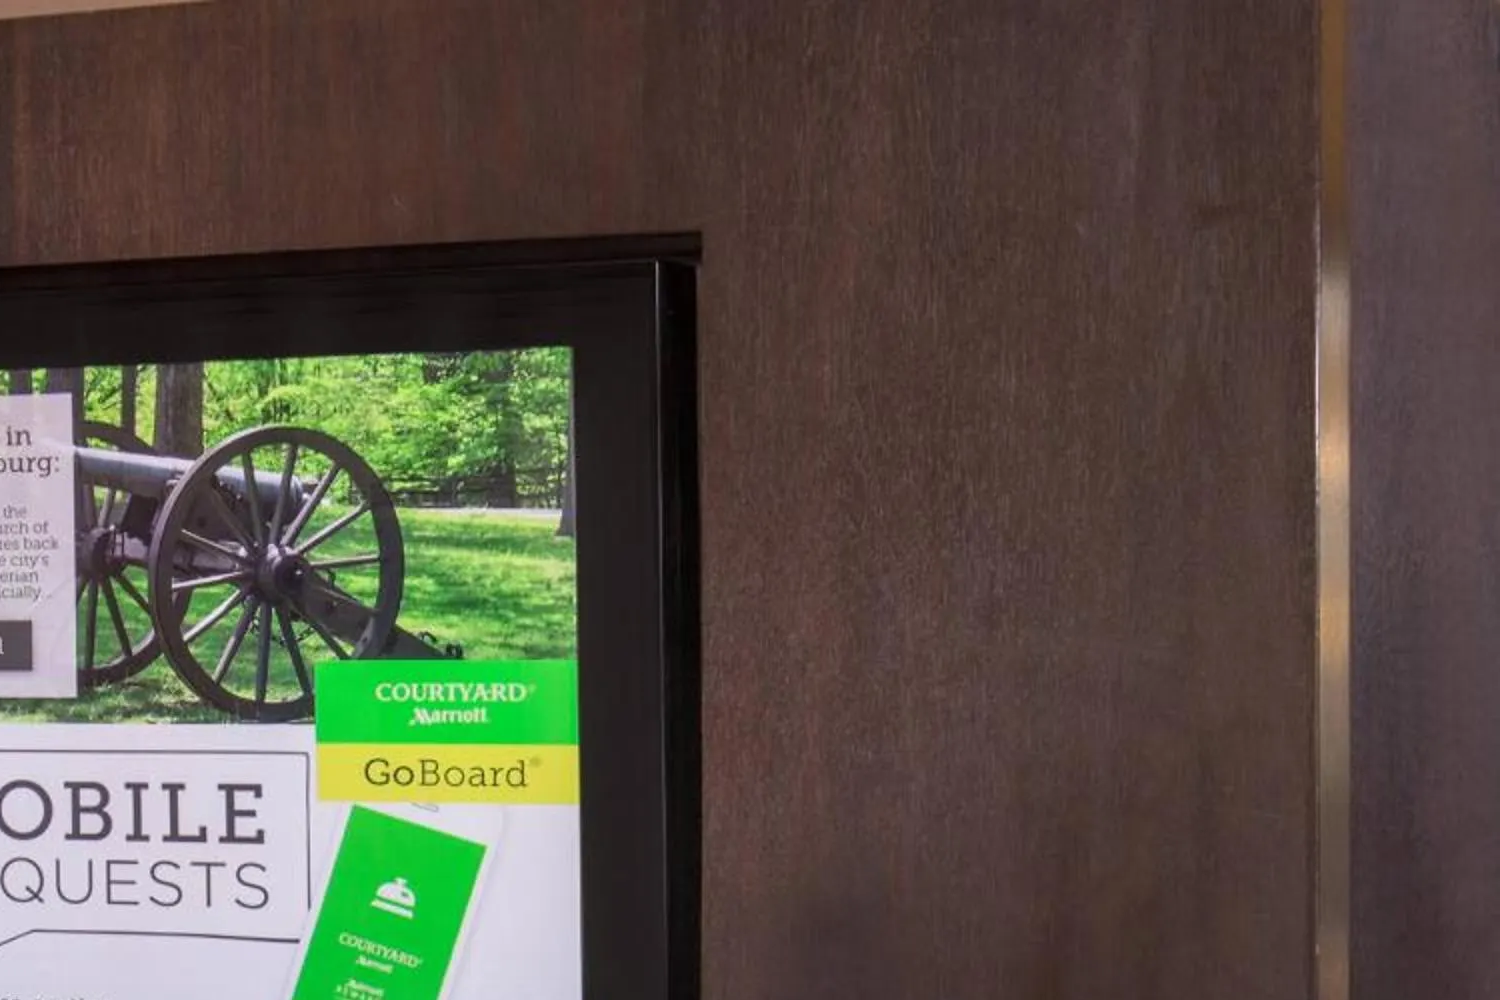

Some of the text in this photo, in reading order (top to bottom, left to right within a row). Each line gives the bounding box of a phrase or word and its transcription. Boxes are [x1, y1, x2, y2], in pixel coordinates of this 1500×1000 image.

[6, 425, 32, 446] in
[3, 504, 27, 518] the
[33, 521, 49, 534] of
[23, 536, 59, 550] back
[10, 554, 49, 570] city's
[408, 706, 488, 726] Marriott
